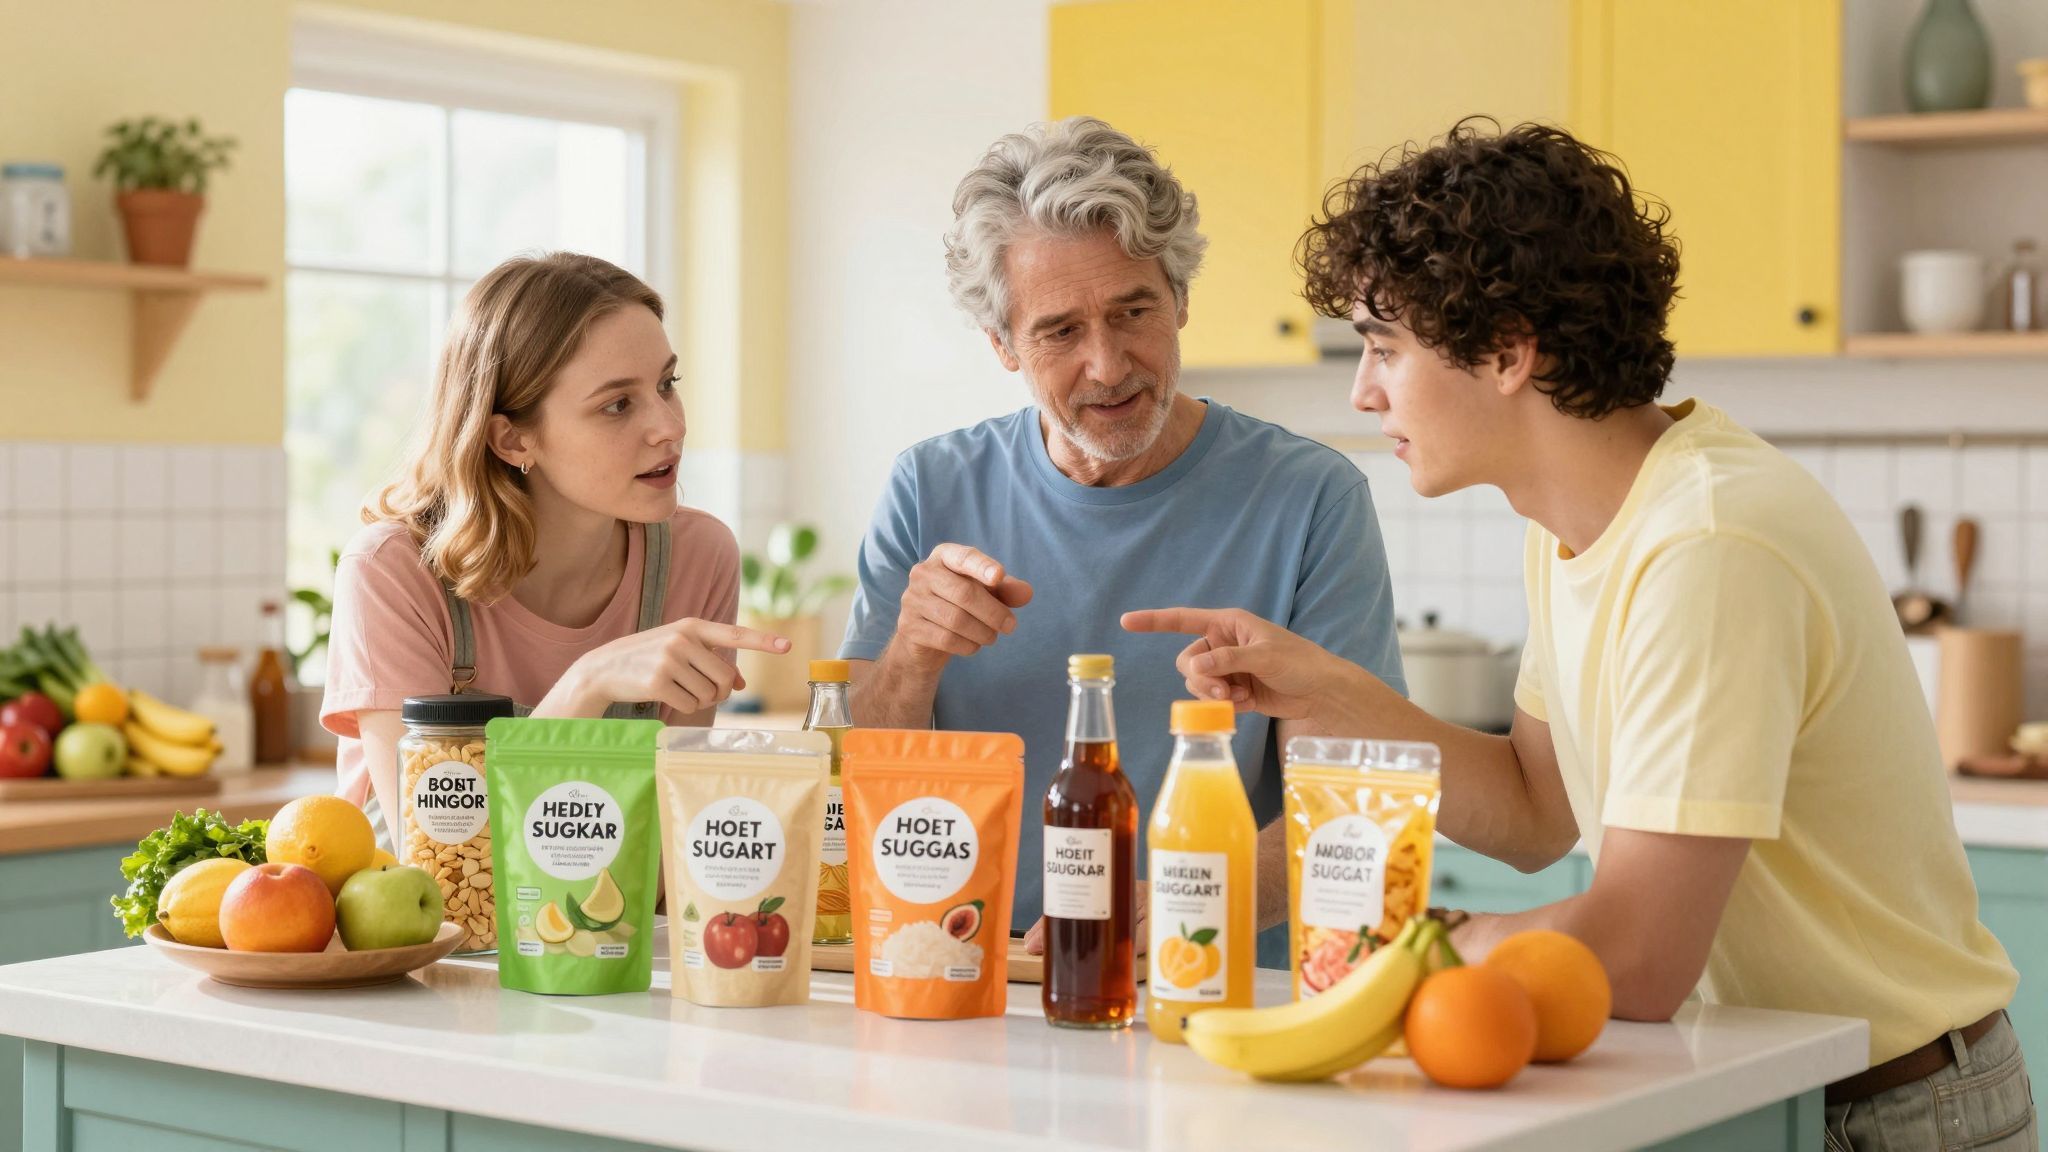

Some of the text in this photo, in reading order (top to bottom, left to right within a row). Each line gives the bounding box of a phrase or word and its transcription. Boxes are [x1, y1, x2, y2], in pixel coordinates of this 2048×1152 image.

[532, 821, 617, 839] SUGKAR
[705, 819, 762, 838] HOET
[896, 816, 956, 836] HOET
[692, 839, 777, 860] SUGART
[881, 838, 970, 859] SUGGAS
